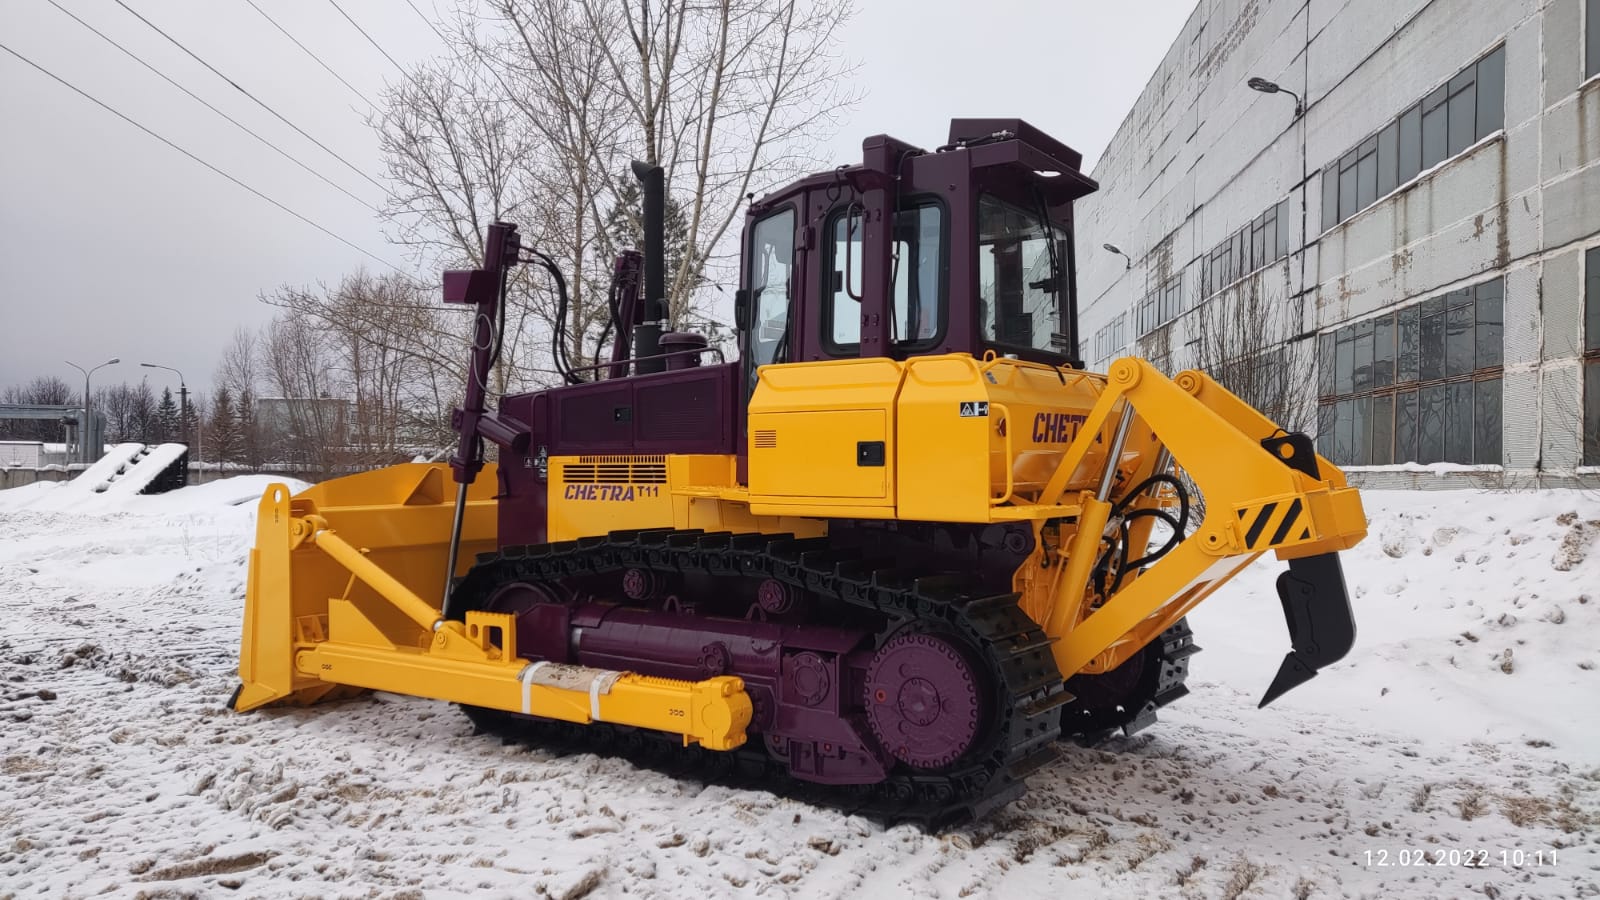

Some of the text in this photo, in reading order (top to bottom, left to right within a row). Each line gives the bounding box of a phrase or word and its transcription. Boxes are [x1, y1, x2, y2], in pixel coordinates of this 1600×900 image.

[1032, 412, 1103, 444] CHET
[564, 484, 659, 501] CHETRA T11
